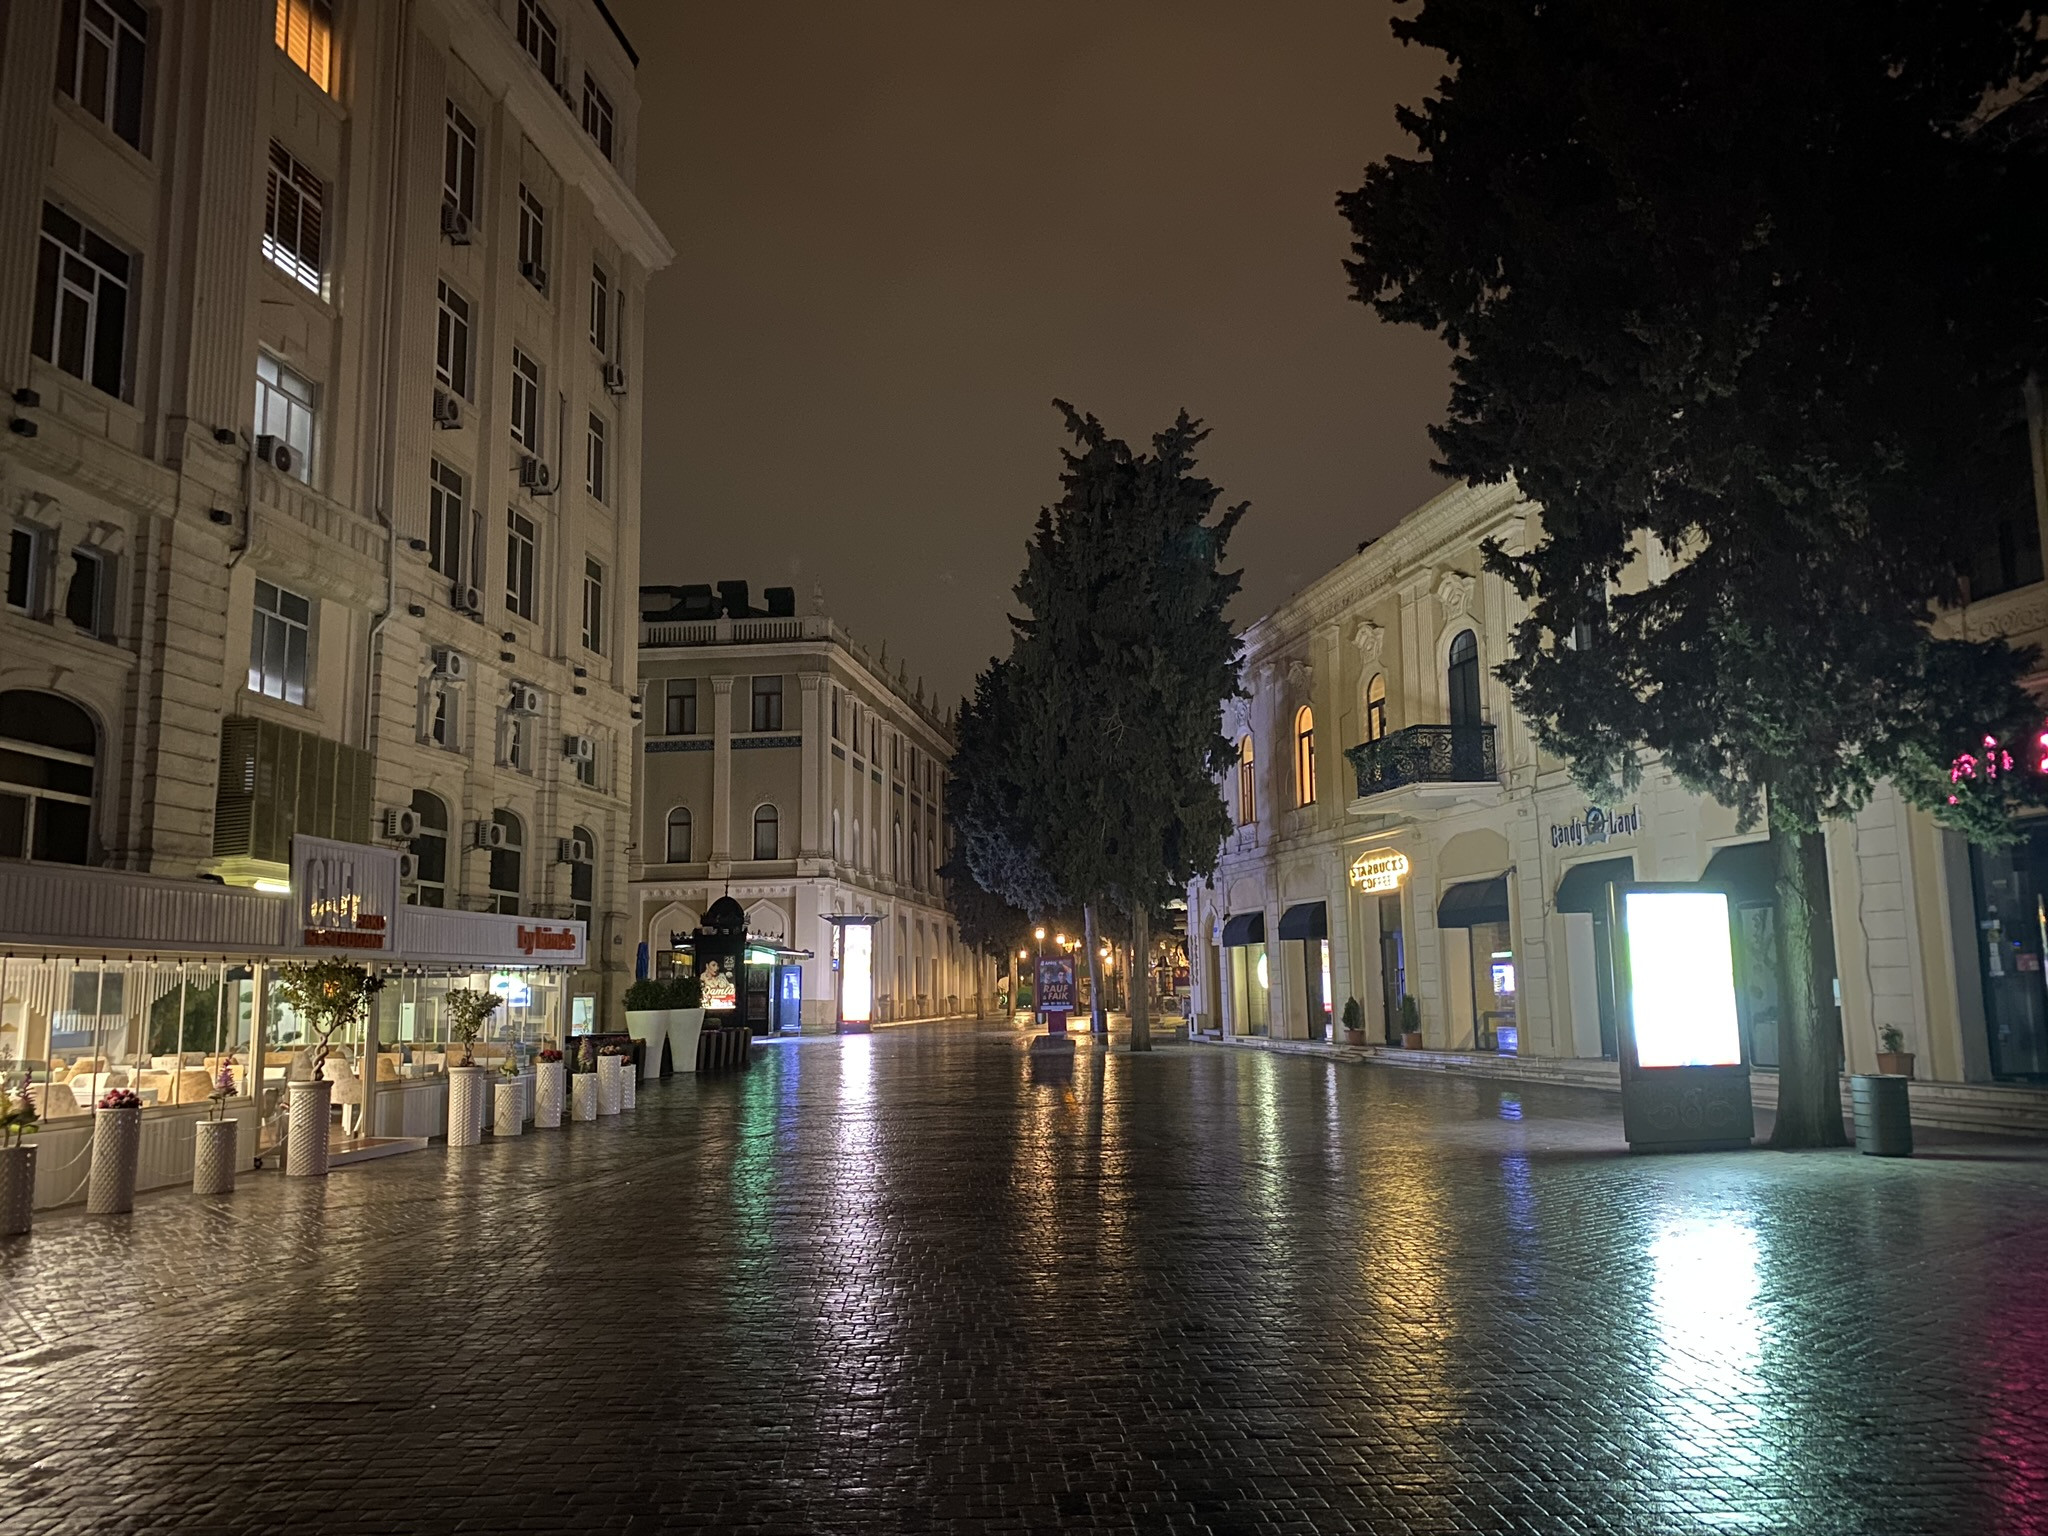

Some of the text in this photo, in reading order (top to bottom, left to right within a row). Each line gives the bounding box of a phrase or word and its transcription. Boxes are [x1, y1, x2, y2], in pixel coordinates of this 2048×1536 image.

[1551, 806, 1639, 848] Candy Land
[1350, 857, 1404, 879] STARBUCKS
[304, 930, 384, 949] RESTAURANT
[517, 925, 534, 955] by
[702, 986, 735, 996] Damla
